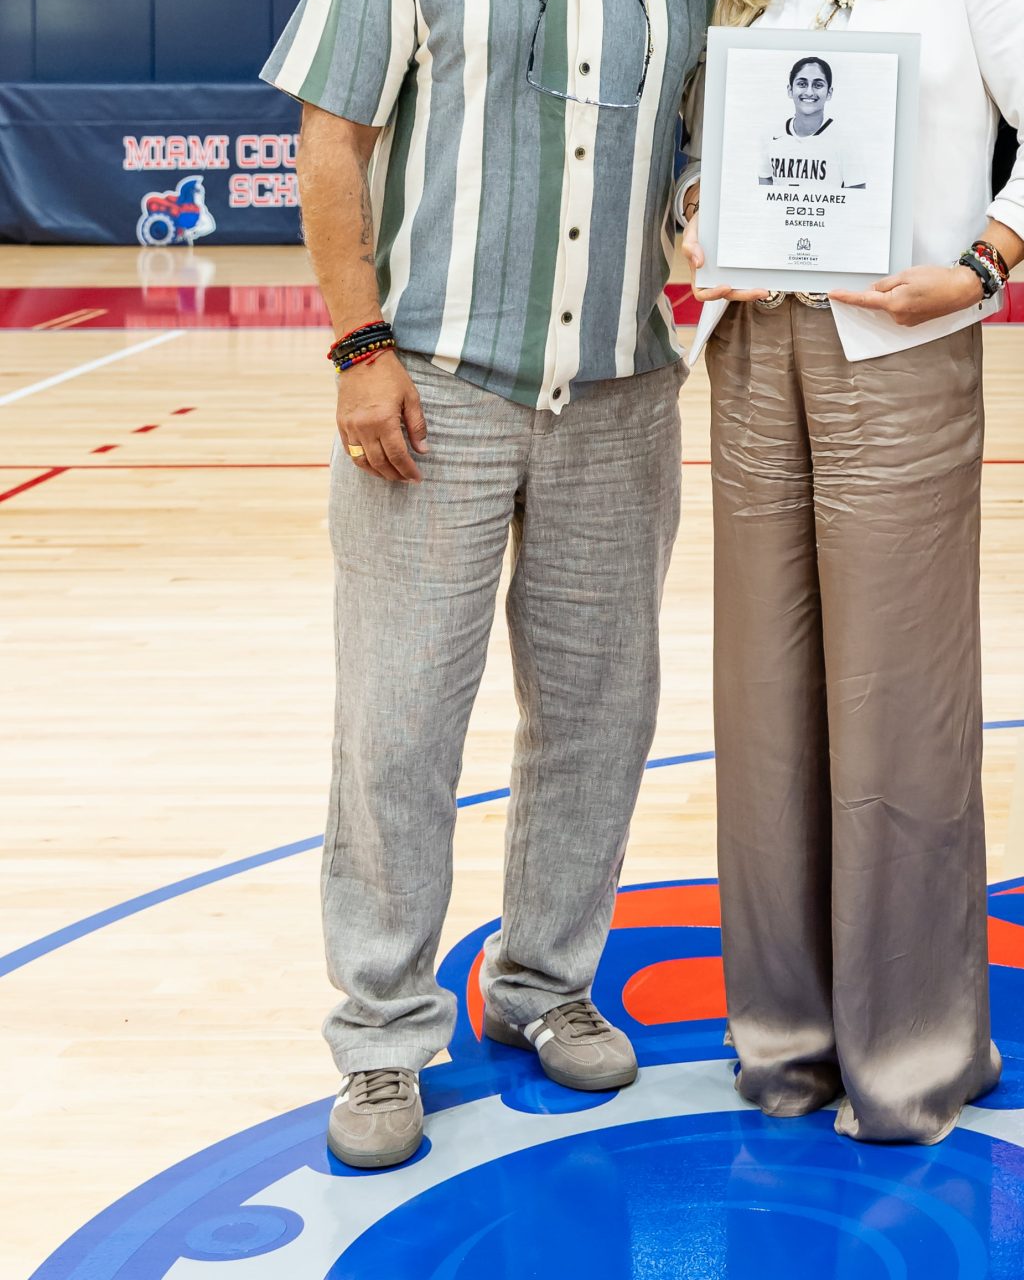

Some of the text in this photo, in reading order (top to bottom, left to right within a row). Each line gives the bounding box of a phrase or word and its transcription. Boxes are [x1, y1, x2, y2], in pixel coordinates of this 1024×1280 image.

[122, 134, 300, 170] MIAMI COU
[228, 173, 301, 208] SCH
[766, 192, 846, 204] MARIA ALVAREZ
[786, 206, 825, 216] 2019
[785, 220, 825, 228] BASKETBALL
